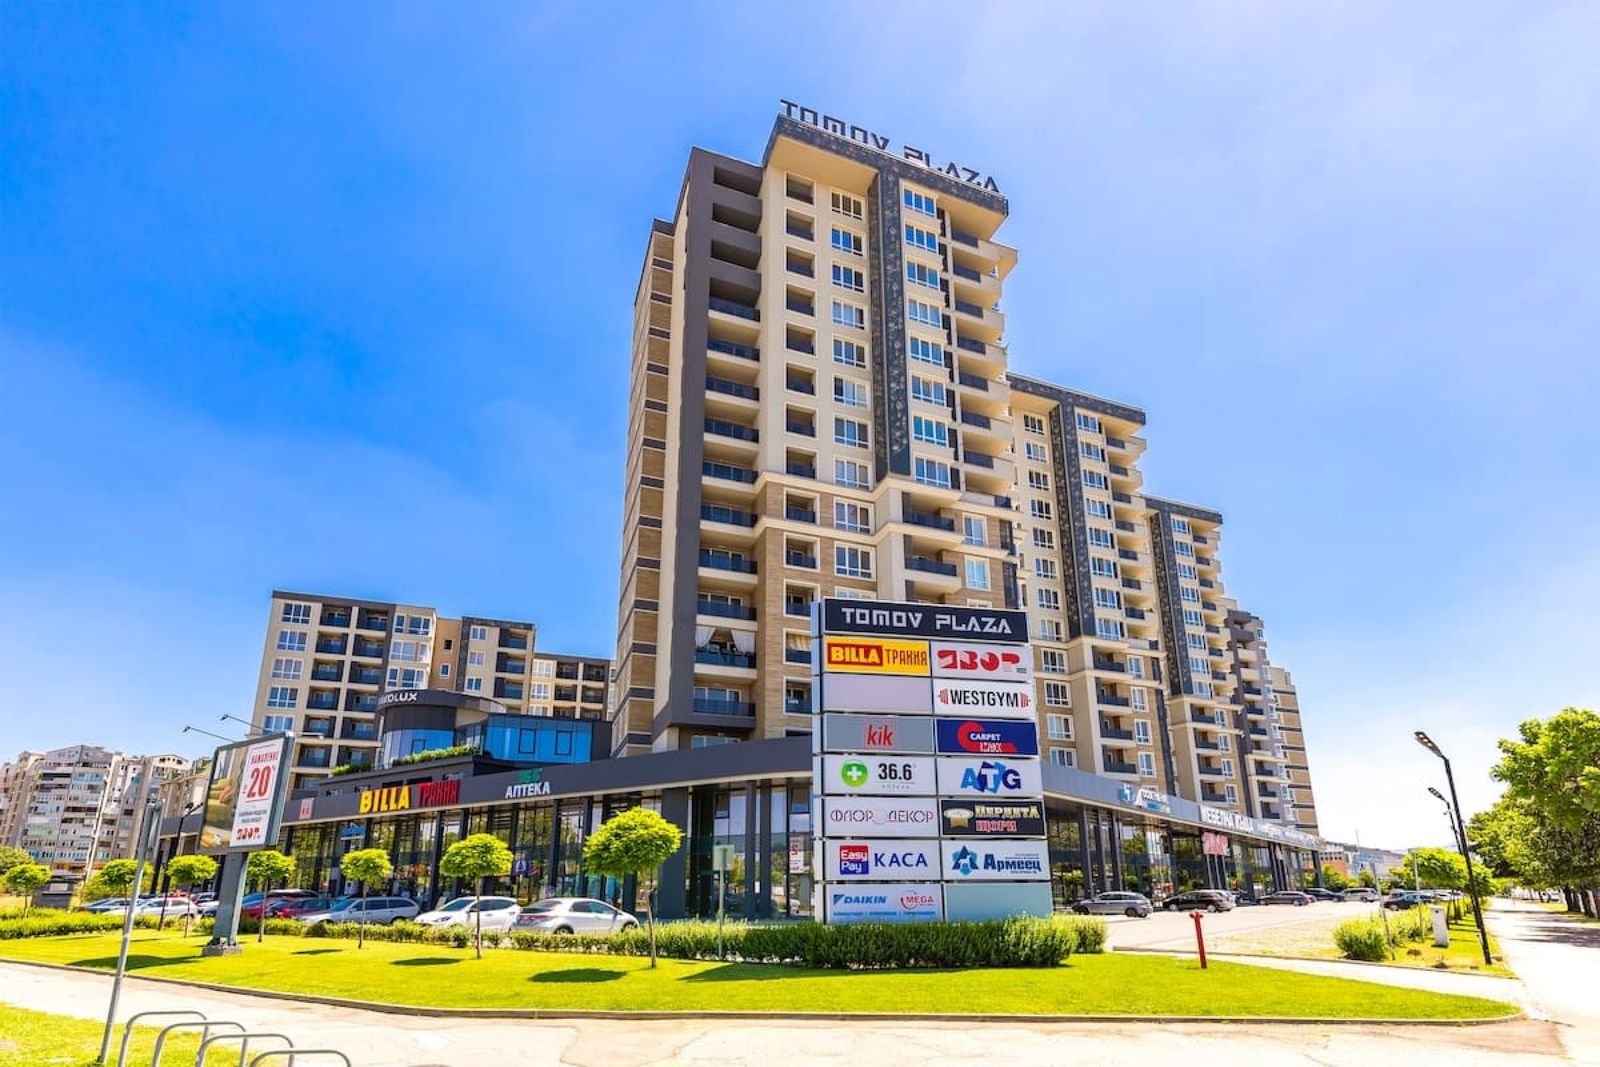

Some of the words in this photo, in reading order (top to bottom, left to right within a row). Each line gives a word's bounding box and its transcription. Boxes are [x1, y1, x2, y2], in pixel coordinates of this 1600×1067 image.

[780, 99, 890, 150] TOMOV
[903, 145, 999, 192] PLAZA
[841, 607, 923, 629] TOMOV
[935, 613, 1012, 634] PLAZA
[831, 646, 881, 664] BILLA
[950, 688, 1019, 708] WESTGYM
[866, 724, 893, 746] kik
[970, 733, 1001, 741] CARPET
[504, 780, 551, 800] АПТЕКА
[359, 785, 411, 814] BILLA
[840, 849, 868, 862] Easy
[874, 852, 928, 868] КАСА
[983, 853, 1042, 872] Армеец
[841, 861, 862, 873] Pay
[844, 895, 887, 904] DAIKIN
[905, 895, 935, 904] MEGA
